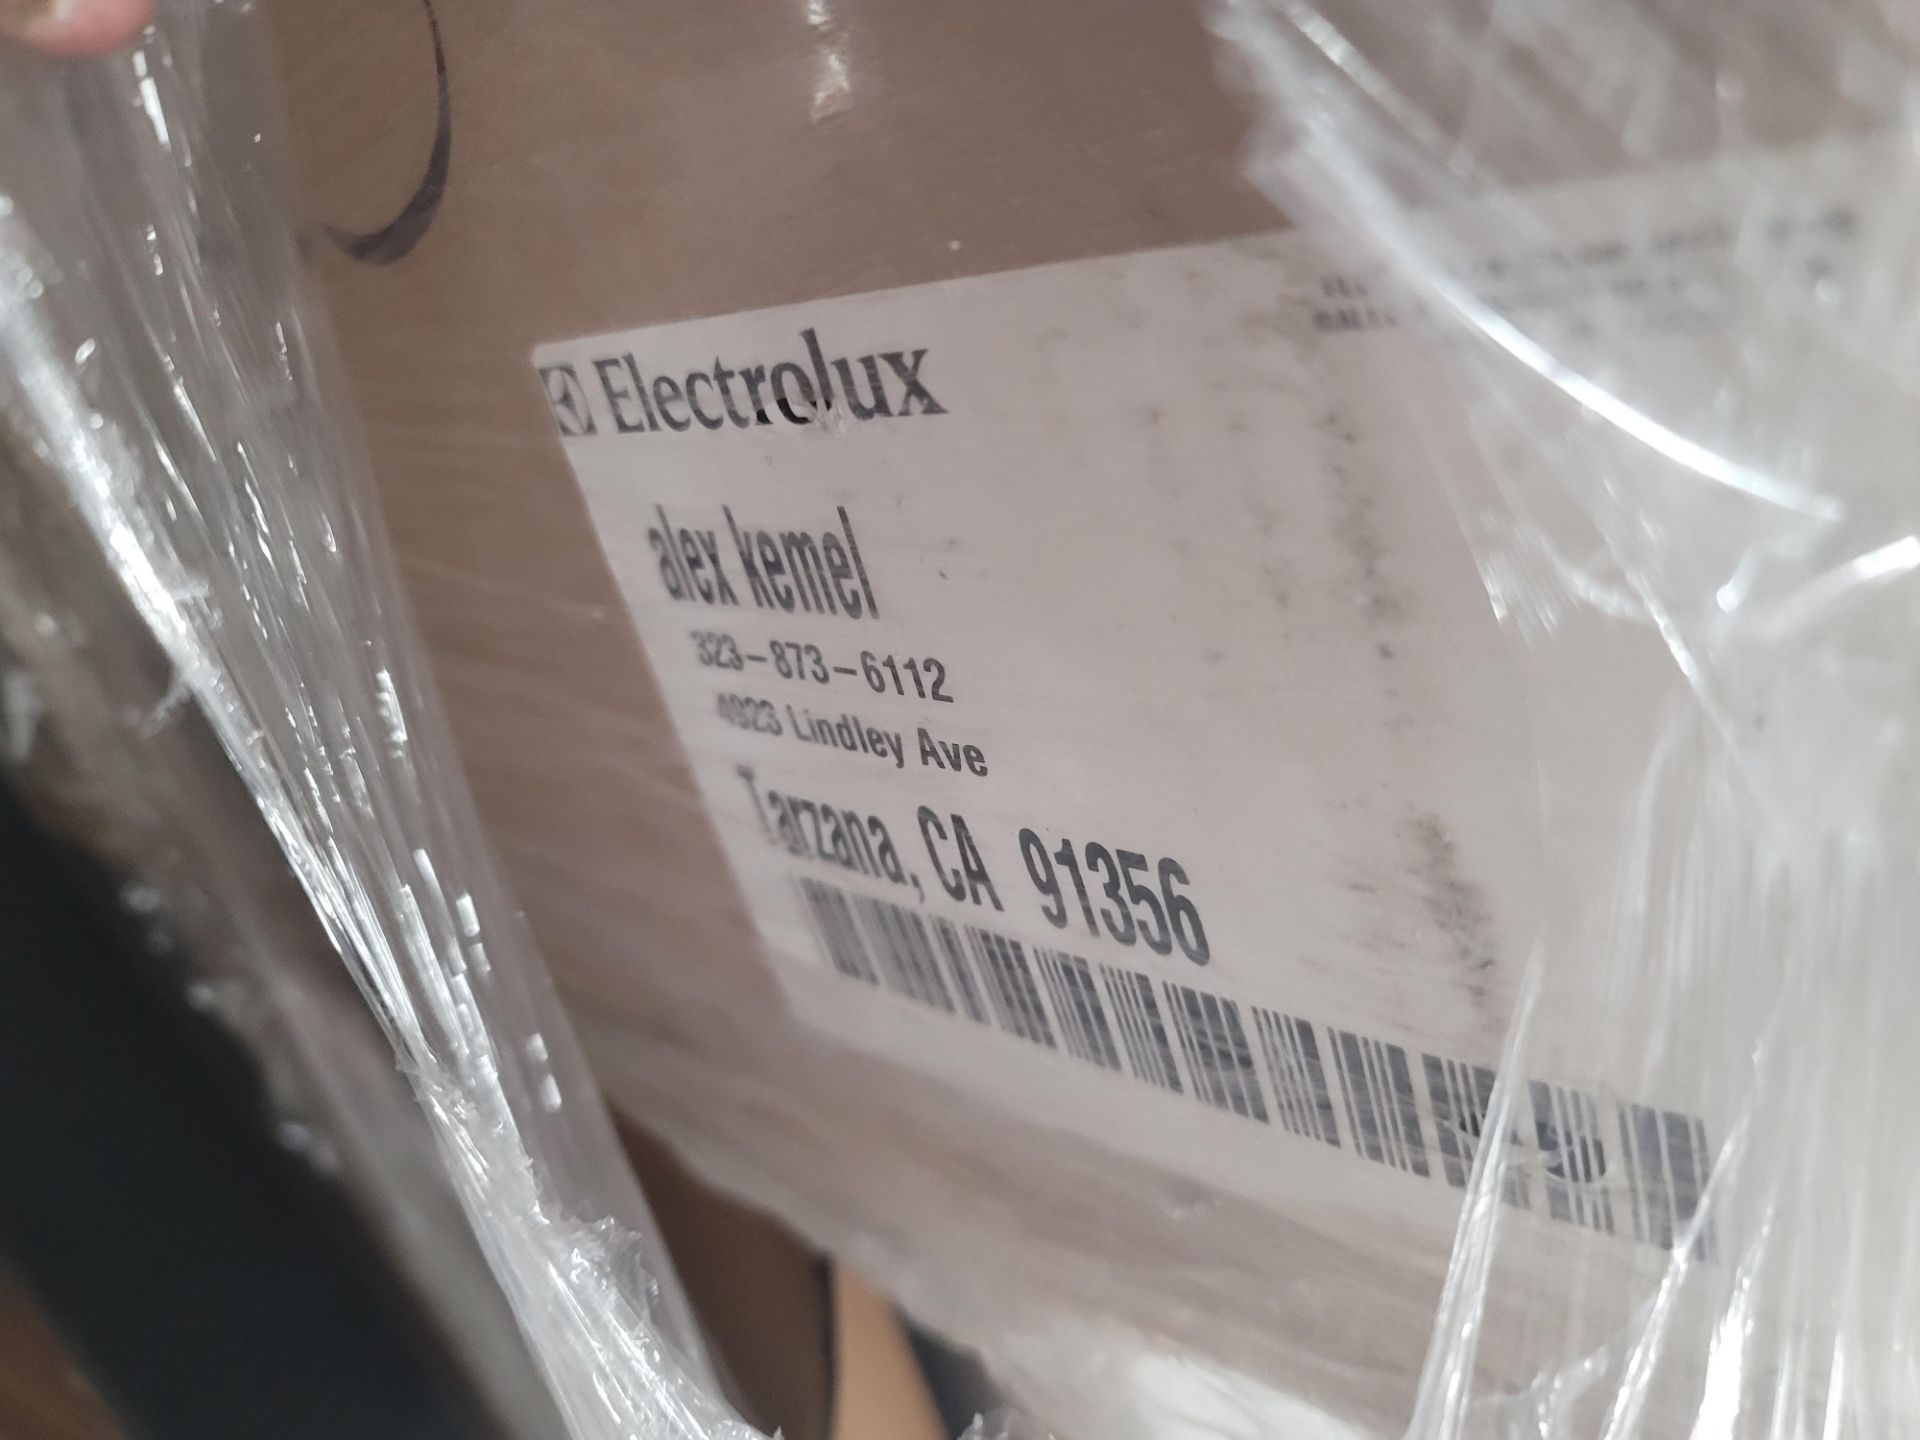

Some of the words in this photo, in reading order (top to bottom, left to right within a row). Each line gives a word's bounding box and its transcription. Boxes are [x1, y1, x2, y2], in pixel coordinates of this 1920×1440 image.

[593, 327, 949, 434] Electrolux
[648, 504, 740, 606] alex
[786, 704, 904, 769] Lindley
[917, 727, 988, 776] Ave
[736, 764, 925, 903] Tarzana,
[917, 805, 1004, 912] CA
[1018, 827, 1210, 966] 91356
